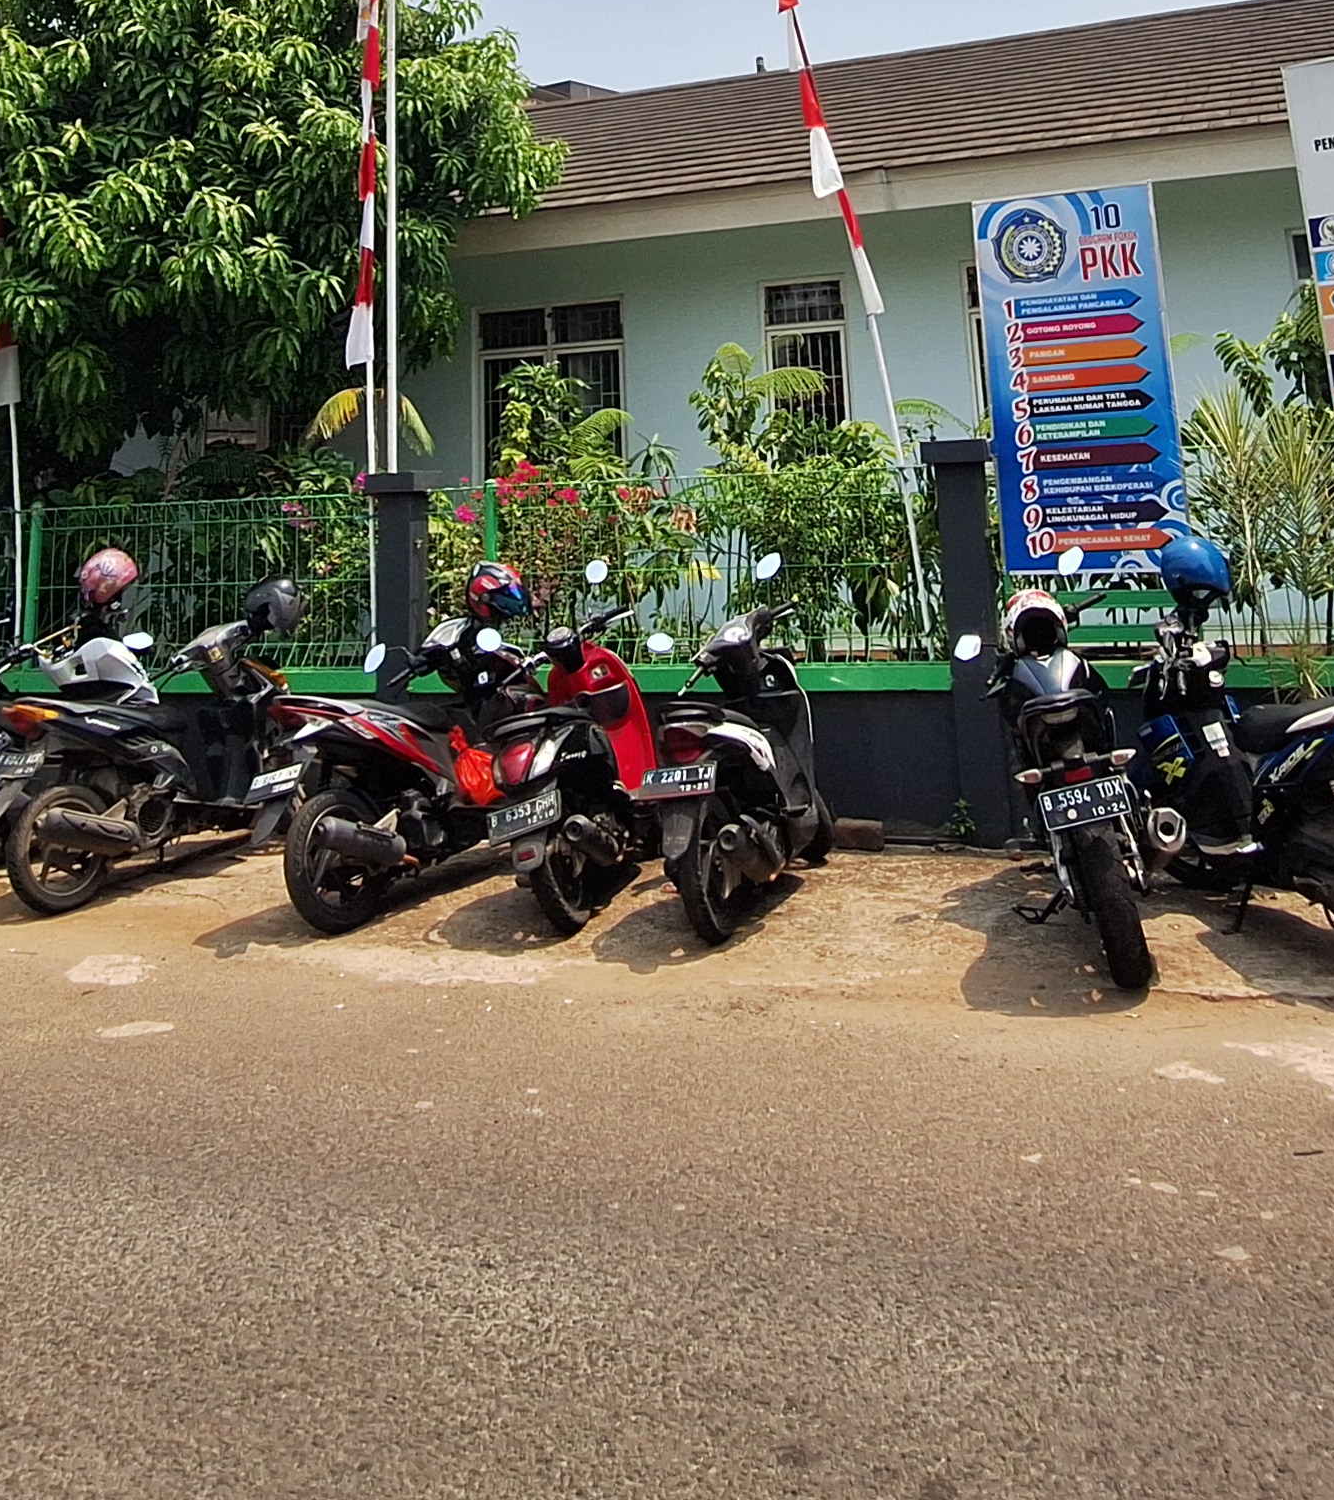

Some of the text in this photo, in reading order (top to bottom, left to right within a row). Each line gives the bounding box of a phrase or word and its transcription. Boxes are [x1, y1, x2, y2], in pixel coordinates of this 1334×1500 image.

[1090, 203, 1121, 230] 10
[1080, 241, 1142, 281] PKK
[1004, 299, 1014, 319] 1
[1080, 293, 1097, 301] DAN
[1078, 298, 1125, 310] PANCASILA
[1006, 321, 1097, 345] 2 GOTONG ROYONG
[1009, 346, 1065, 369] 3 PANGAN
[1012, 371, 1075, 392] 4 SANDANG
[1013, 395, 1029, 419] 5
[1032, 395, 1085, 405] PERUMAHAN
[1104, 392, 1127, 400] TATA
[1033, 399, 1142, 414] LAKSANA RUMAH TANGGA
[1017, 420, 1106, 445] 6 PENDIDIKAN DAN
[1036, 429, 1101, 440] KETERAMPILAN
[1019, 448, 1091, 472] 7 KESEHATAN
[1022, 475, 1113, 500] 8 PENGEMBANGAN
[1043, 481, 1154, 495] KEHIDUPAN BERKOPERASI
[1026, 505, 1104, 530] 9 KELESTARIAN
[1110, 512, 1137, 520] HIDUP
[1028, 531, 1152, 556] 10 PERENCANAAN SEHAT
[646, 773, 654, 784] K
[660, 769, 687, 783] 2201
[1042, 779, 1123, 812] B 5594 TDX
[490, 815, 498, 829] B
[505, 803, 531, 822] 6353
